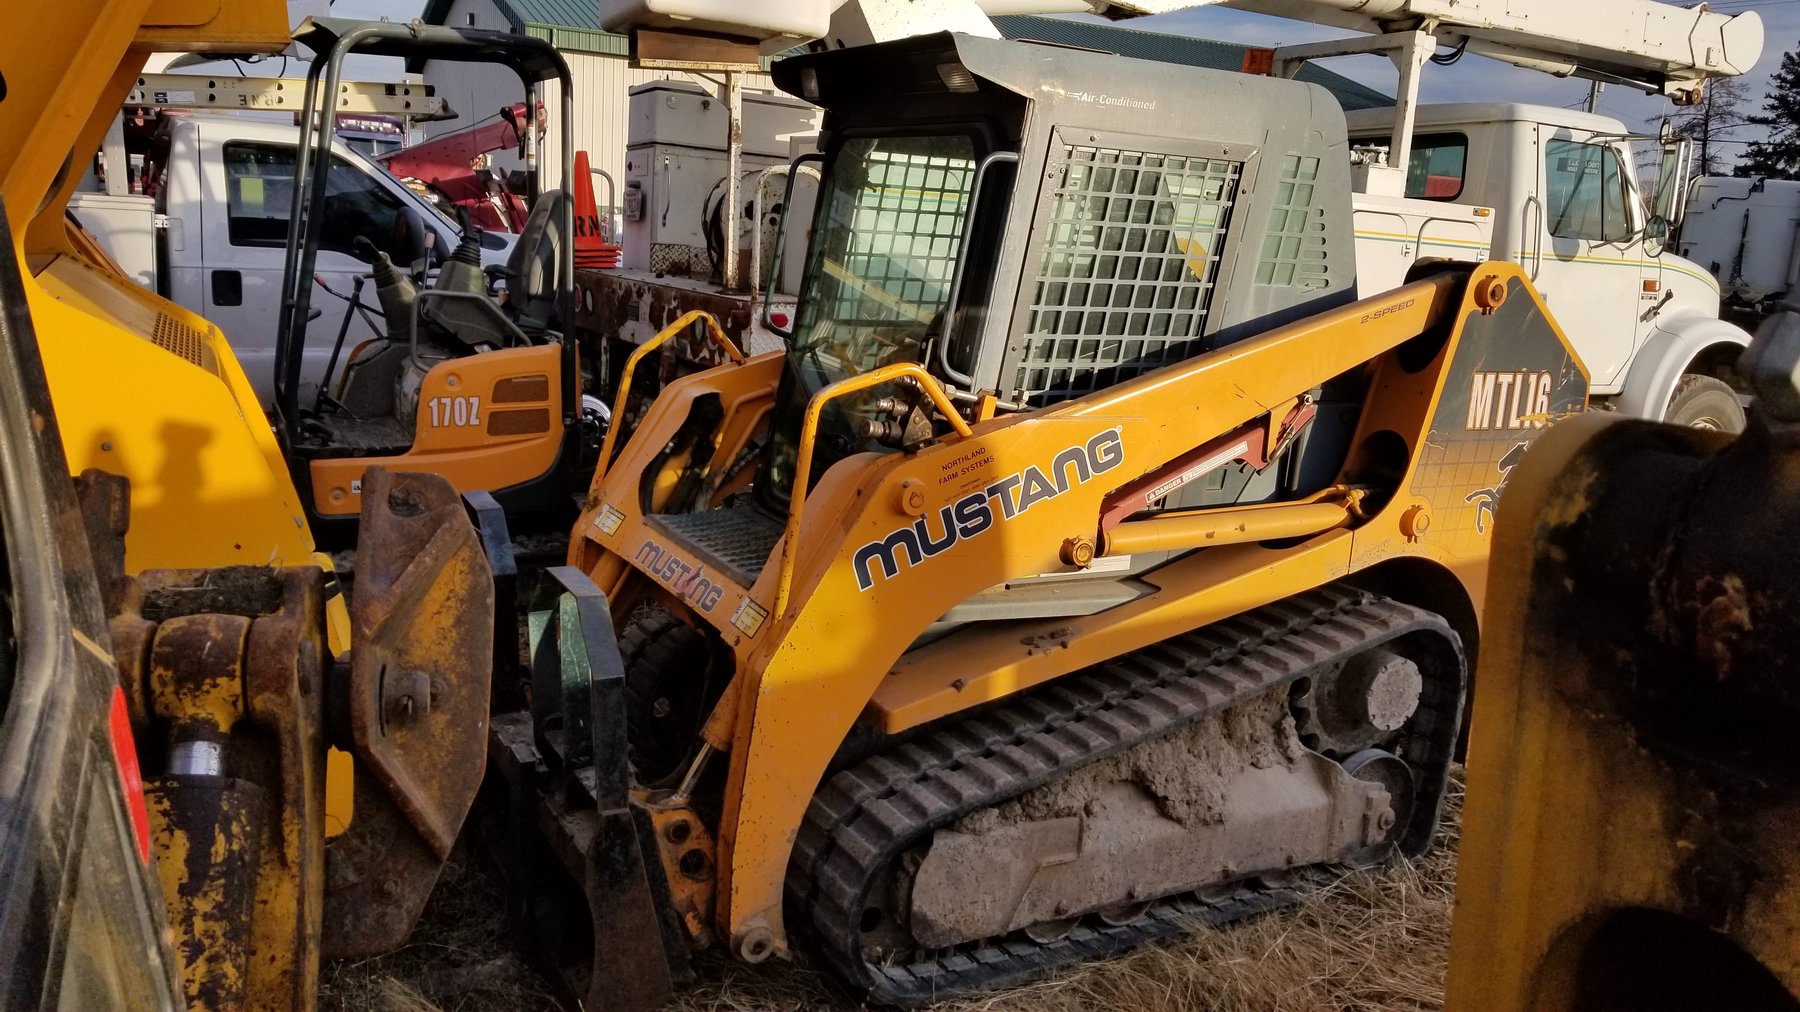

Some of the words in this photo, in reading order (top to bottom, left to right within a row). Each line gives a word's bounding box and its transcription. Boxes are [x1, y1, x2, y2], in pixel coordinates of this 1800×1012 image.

[1080, 91, 1156, 110] Air-Conditioned
[1360, 299, 1415, 324] 2-SPEED
[428, 396, 481, 428] 170Z
[1465, 371, 1552, 431] MTL16
[938, 471, 959, 486] FARM
[960, 455, 995, 475] SYSTEMS
[941, 447, 986, 472] NORTHLAND
[1155, 478, 1182, 496] DANGER
[853, 427, 1124, 592] MUSTANG
[634, 539, 725, 614] MUSTANG
